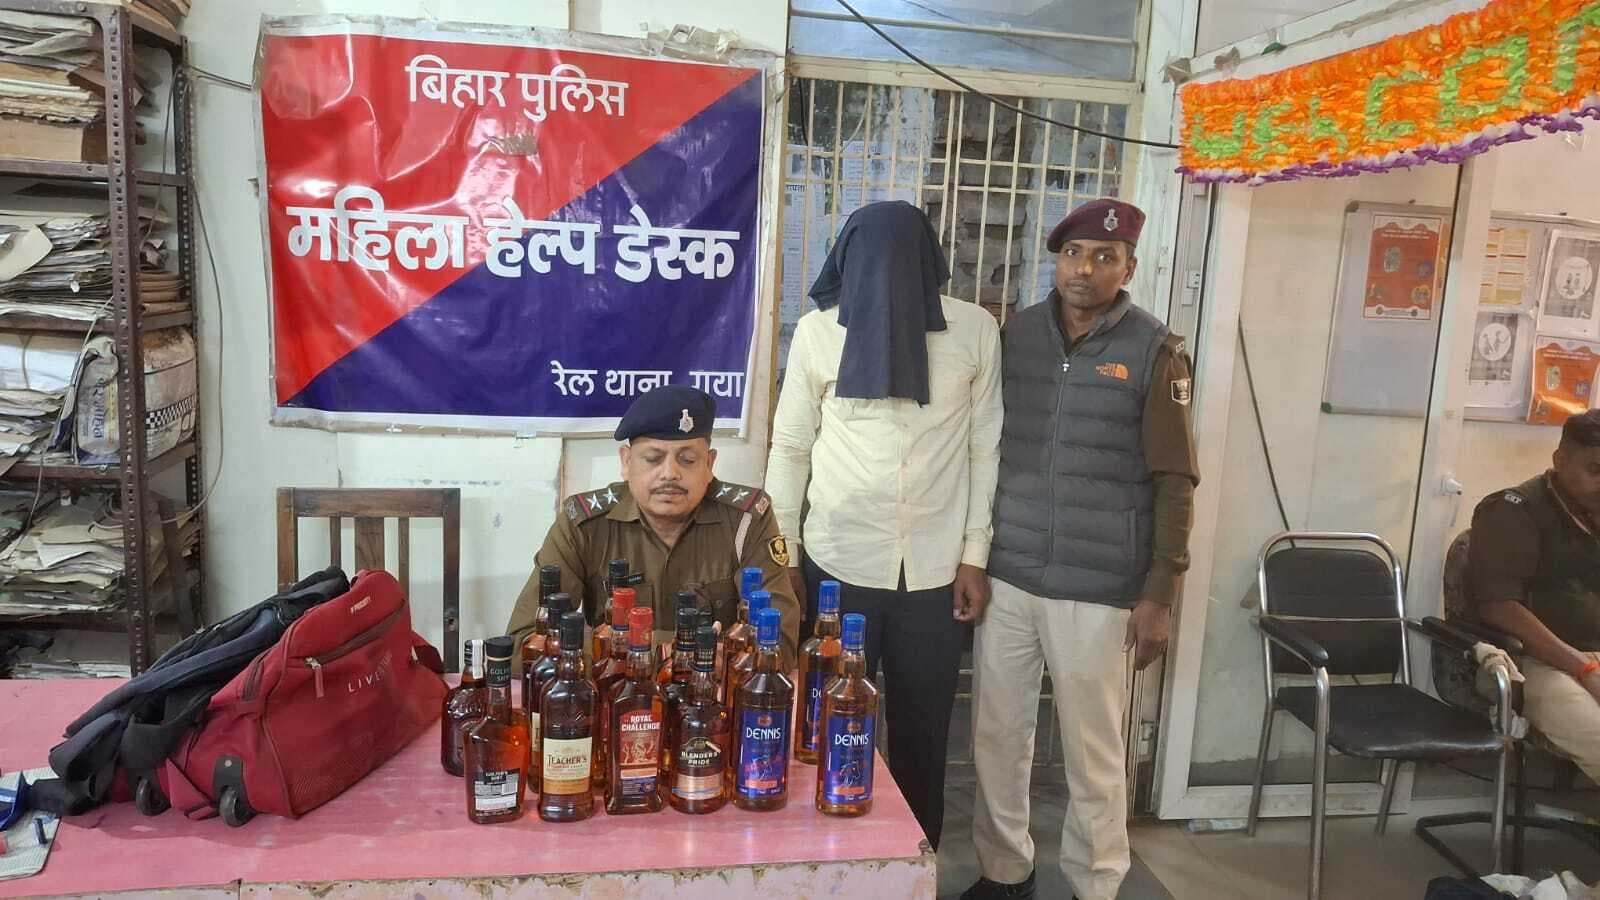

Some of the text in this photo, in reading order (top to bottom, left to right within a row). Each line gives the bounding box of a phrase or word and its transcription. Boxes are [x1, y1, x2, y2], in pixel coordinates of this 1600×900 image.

[405, 54, 628, 121] बिहार पुलिस
[286, 185, 469, 272] महिला
[482, 196, 601, 278] हेल्प
[613, 205, 740, 283] डेस्क
[550, 360, 598, 396] रेल
[689, 371, 745, 397] गया
[630, 714, 653, 723] ROYAL
[621, 721, 661, 732] CHALLENGE
[745, 727, 781, 740] DENNIS
[834, 733, 871, 747] DENNIS
[687, 758, 711, 766] PRIDE
